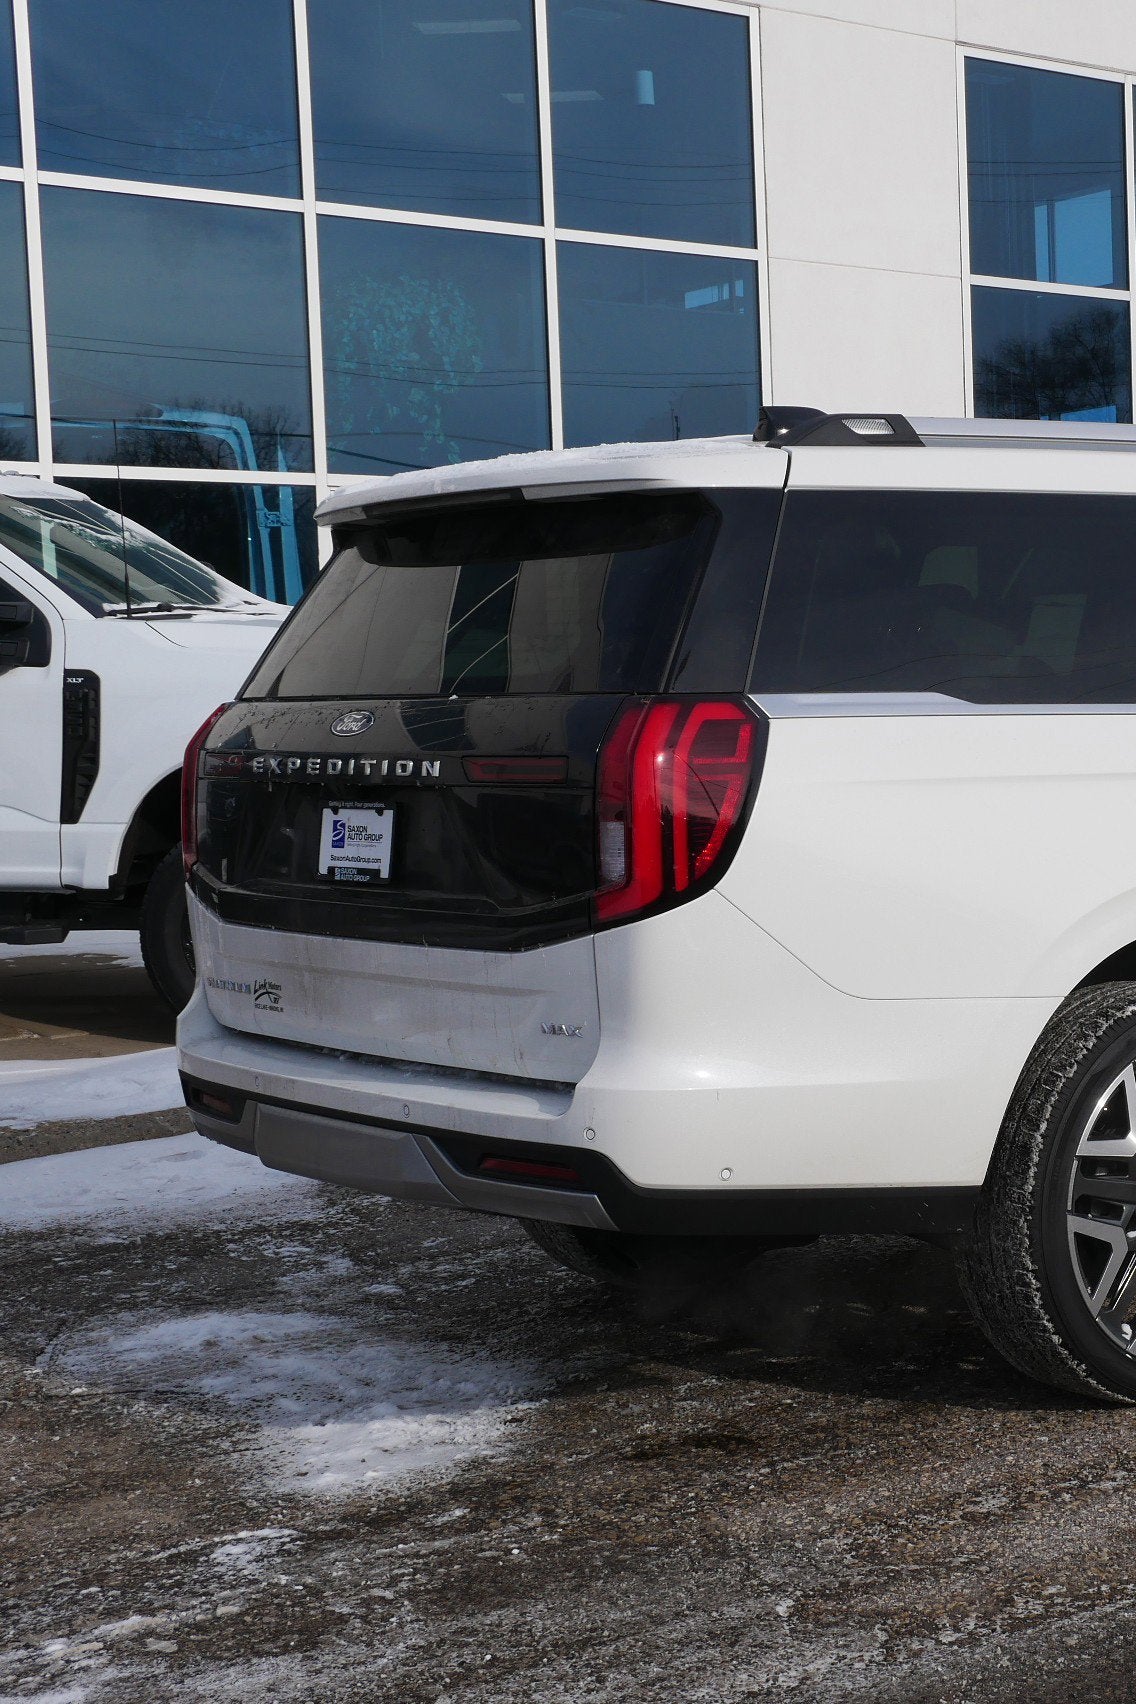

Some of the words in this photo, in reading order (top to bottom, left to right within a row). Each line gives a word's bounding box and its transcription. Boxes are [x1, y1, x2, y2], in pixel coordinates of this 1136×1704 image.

[252, 757, 441, 777] EXPEDITION
[347, 825, 368, 833] SAXON
[347, 833, 363, 841] AUTO
[364, 833, 383, 842] GROUP
[330, 854, 382, 864] SaxonAutoGroup.com
[541, 1022, 584, 1038] MAX
